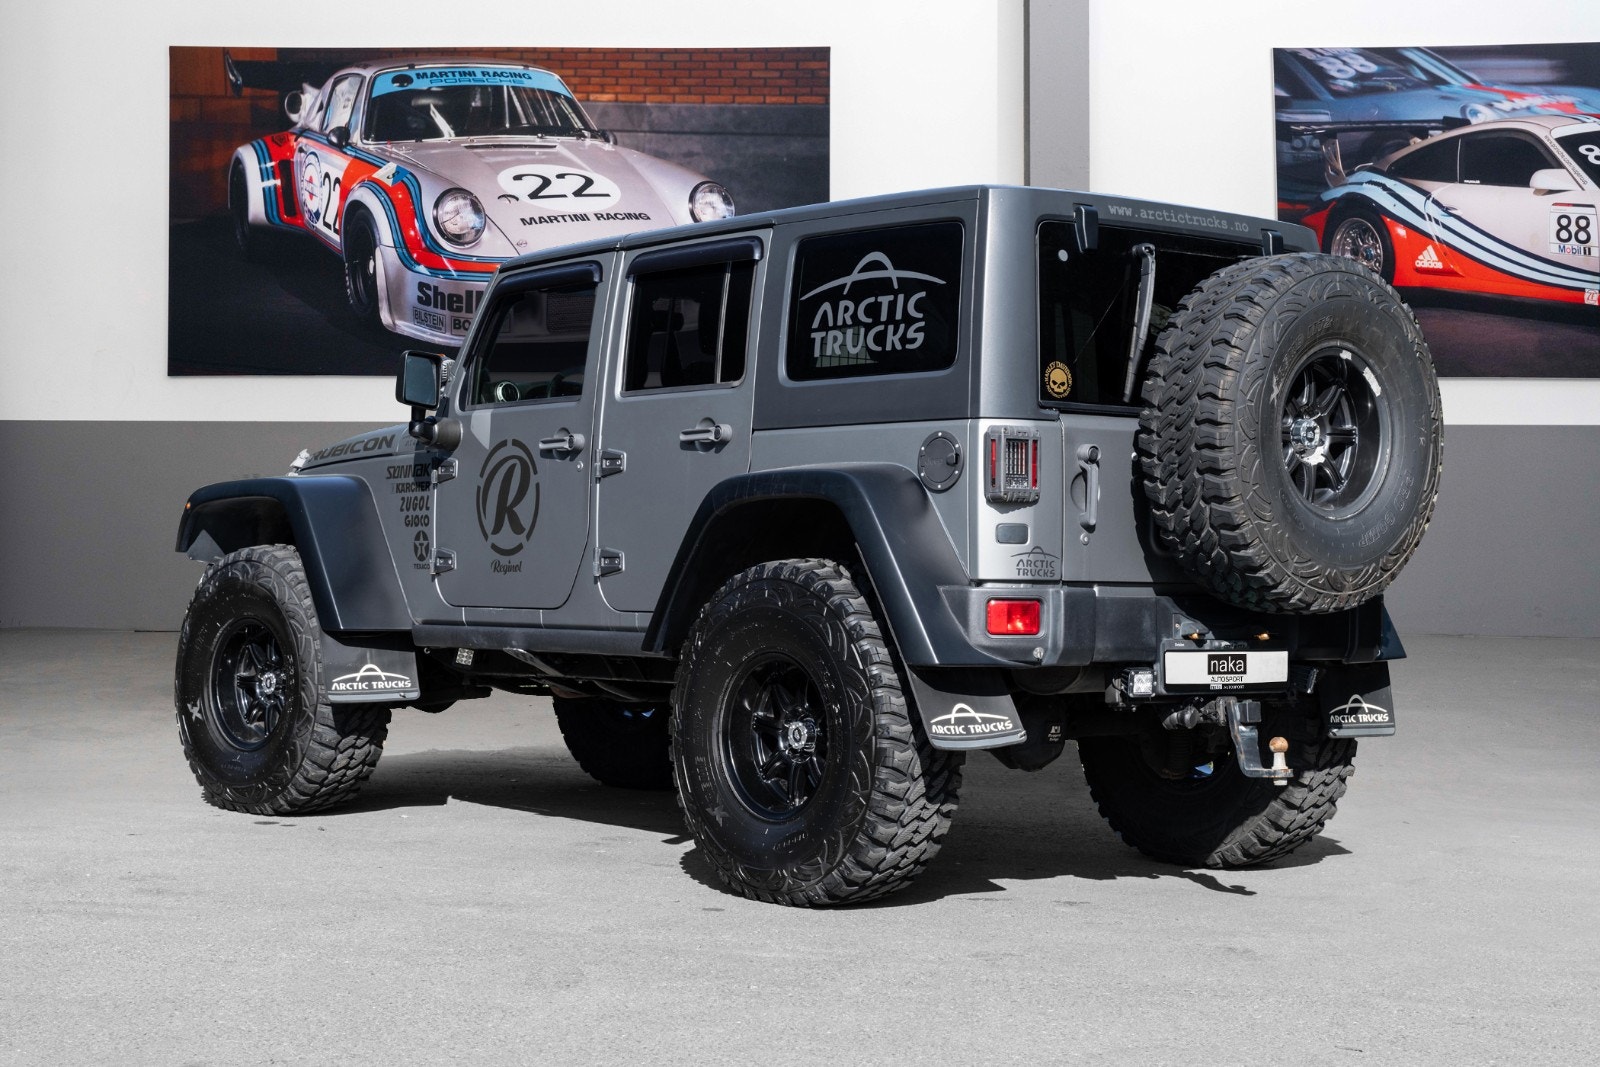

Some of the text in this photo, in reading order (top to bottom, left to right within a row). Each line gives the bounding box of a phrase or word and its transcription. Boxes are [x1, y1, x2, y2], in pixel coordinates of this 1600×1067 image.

[415, 70, 532, 80] MARTINI RACING
[513, 173, 611, 200] 22
[520, 212, 651, 226] MARTINI RACING
[1108, 203, 1249, 233] www.arctictrucks.no
[1556, 214, 1592, 244] 88
[1558, 244, 1581, 255] Mobil
[1415, 259, 1443, 269] adidas
[417, 281, 485, 314] Shell
[414, 309, 444, 328] BILSTEIN
[811, 291, 927, 329] ARCTIC
[453, 318, 471, 332] BO
[810, 321, 926, 358] TRUCKS
[308, 434, 396, 463] RUBICON
[481, 454, 531, 535] R
[400, 495, 430, 512] ZUGOL
[1016, 559, 1055, 569] ARCTIC
[1016, 567, 1056, 578] TRUCKS
[1210, 655, 1244, 672] naka
[331, 680, 412, 691] ARCTIC TRUCKS
[1330, 713, 1389, 723] ARCTIC TRUCKS
[931, 720, 1013, 735] ARCTIC TRUCKS
